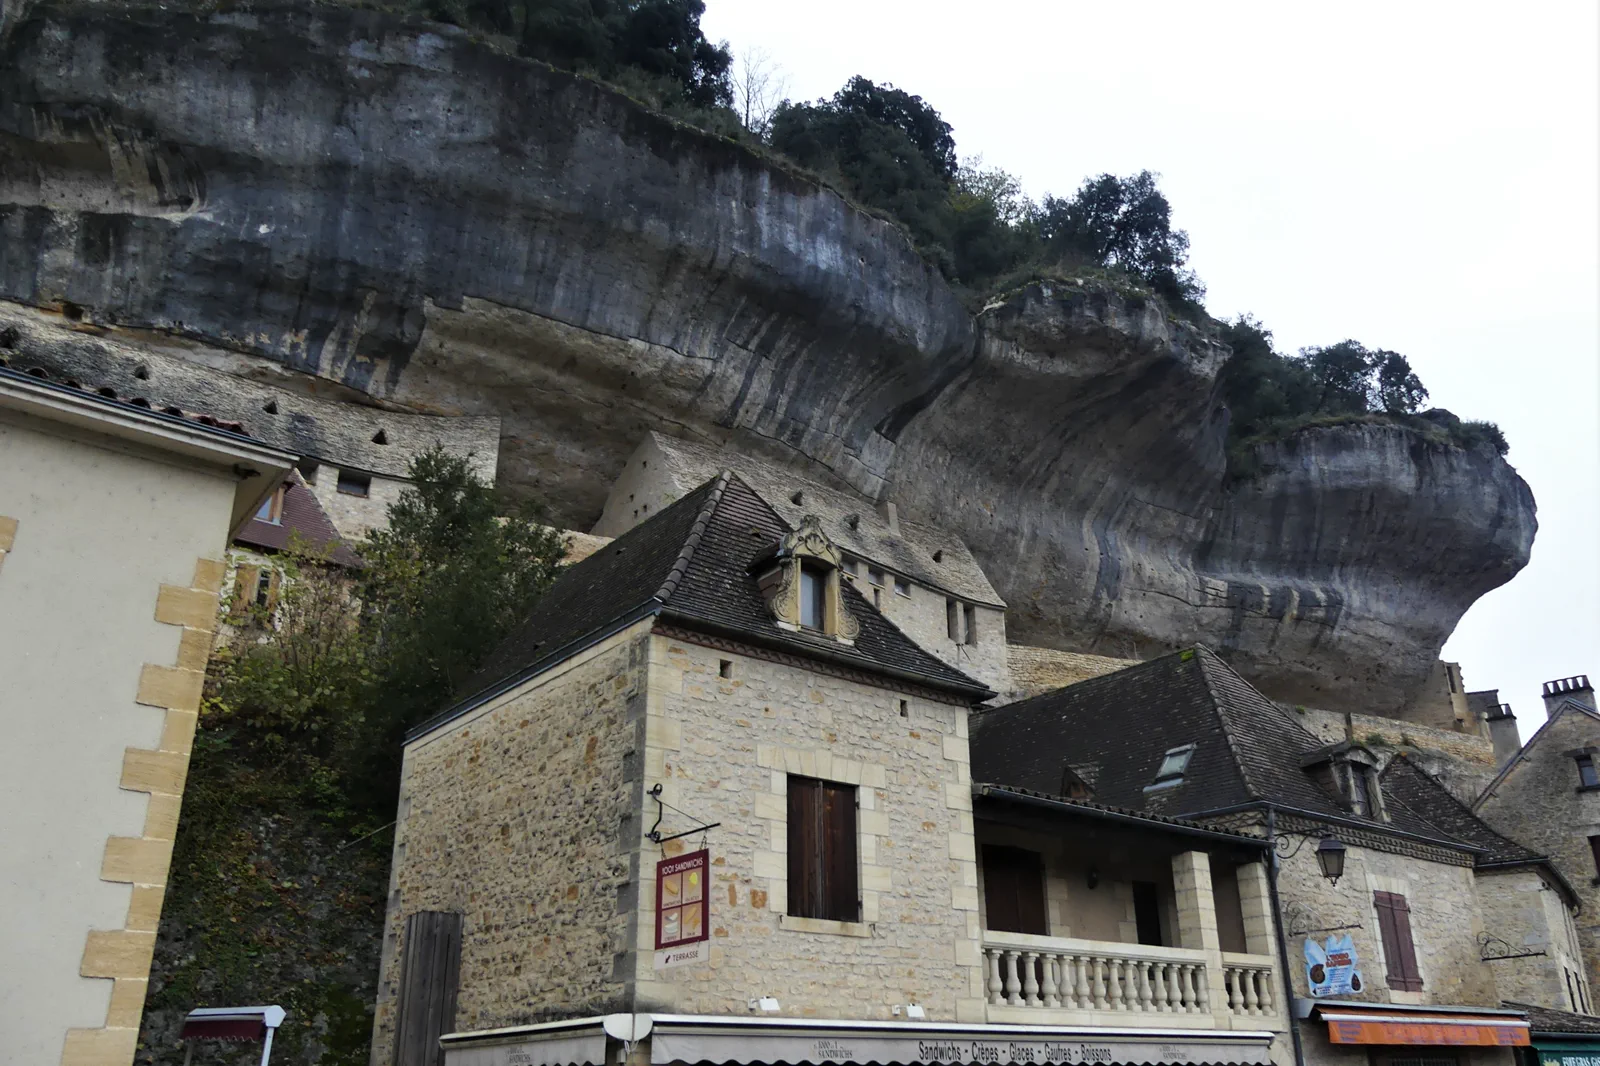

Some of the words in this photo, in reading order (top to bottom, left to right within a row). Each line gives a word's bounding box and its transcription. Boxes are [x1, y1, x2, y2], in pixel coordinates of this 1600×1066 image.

[672, 950, 699, 962] TERRASSE
[918, 1041, 962, 1061] Sandwichs
[1009, 1042, 1034, 1061] Glaces
[1044, 1042, 1072, 1061] Gaufres
[1081, 1044, 1112, 1062] Boissons
